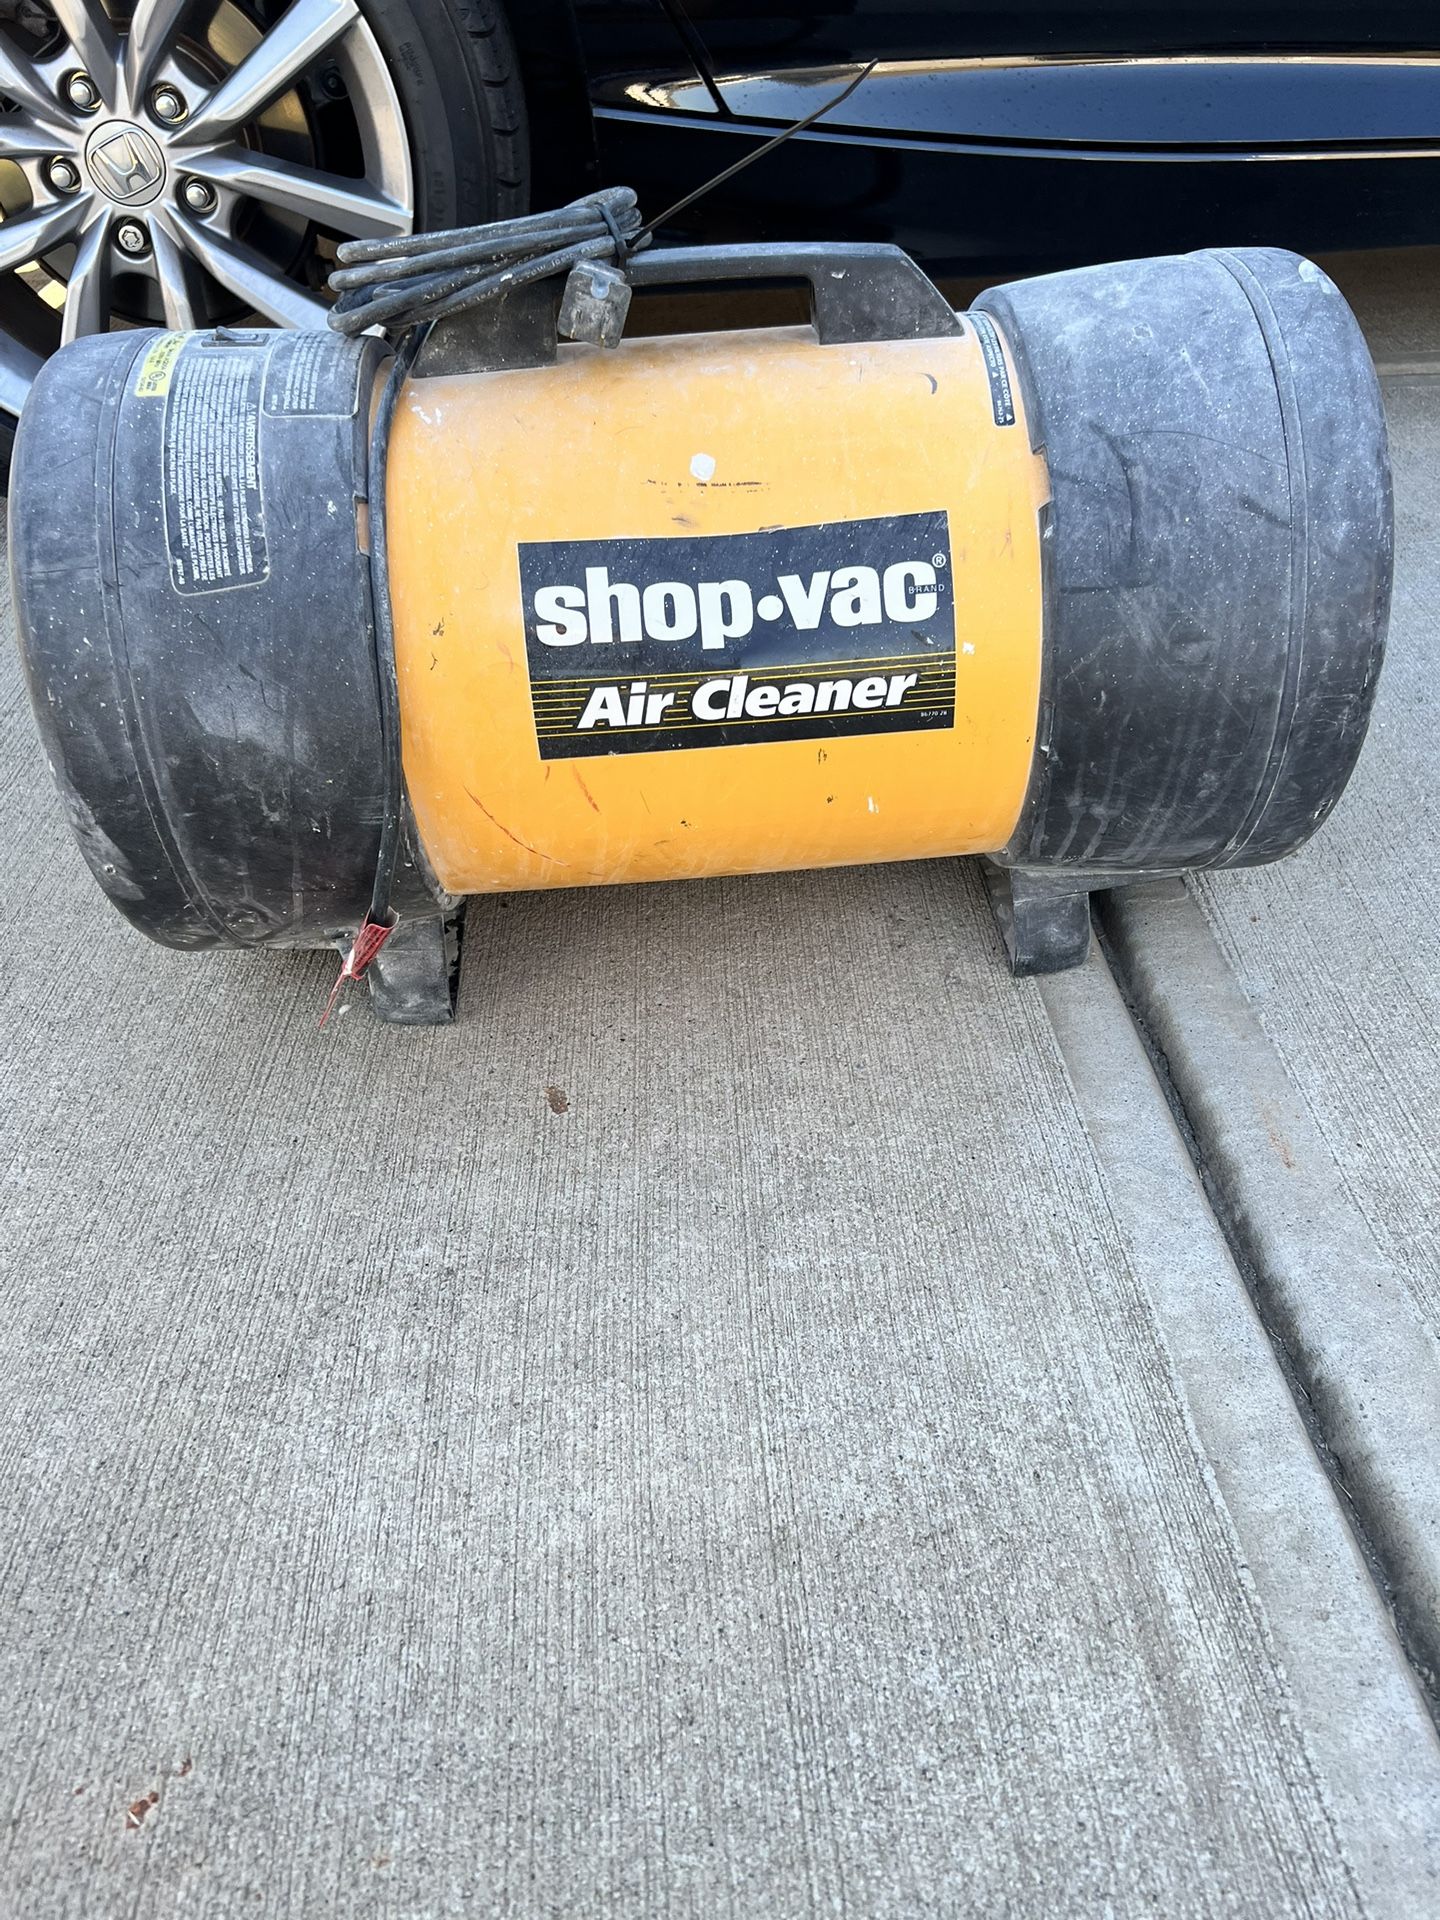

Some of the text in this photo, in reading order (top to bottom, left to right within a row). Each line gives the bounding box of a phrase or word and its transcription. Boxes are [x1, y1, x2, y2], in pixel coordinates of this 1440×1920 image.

[201, 572, 208, 581] DE
[908, 583, 945, 594] BRAND
[577, 673, 918, 729] Air Cleaner
